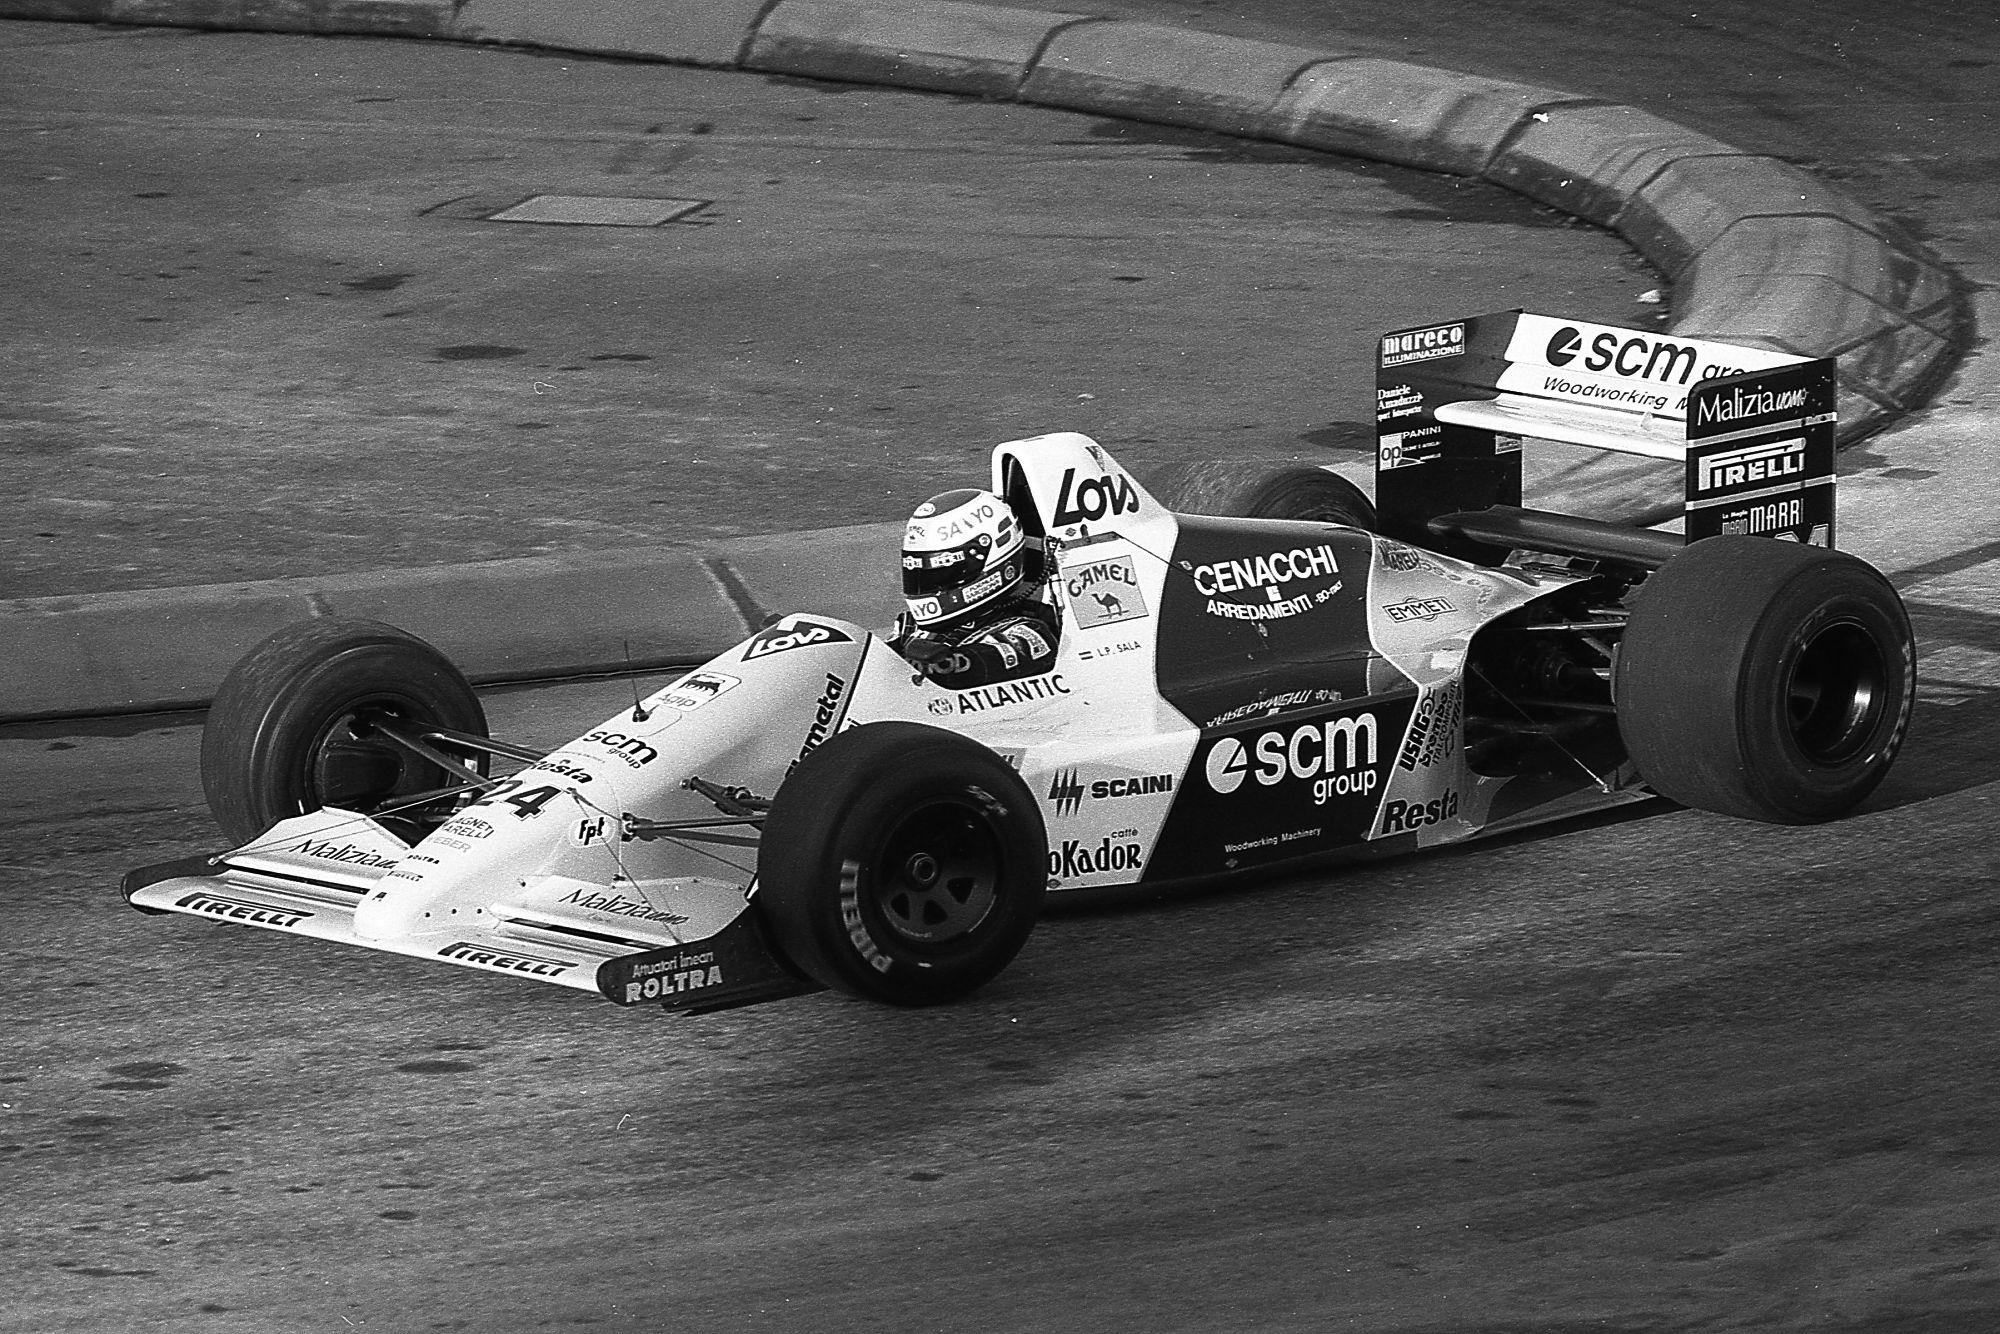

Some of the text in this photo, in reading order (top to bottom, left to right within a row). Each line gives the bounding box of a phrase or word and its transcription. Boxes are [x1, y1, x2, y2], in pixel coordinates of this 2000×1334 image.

[1384, 327, 1463, 355] mareco
[1384, 345, 1463, 365] ILLUMINAZIONE
[1584, 332, 1697, 385] scm
[1543, 376, 1668, 409] Woodworking
[1698, 384, 1774, 426] Malizia
[1402, 426, 1442, 440] PANINI
[1698, 437, 1806, 491] PIRELLI
[1068, 564, 1136, 597] CAMEL
[1194, 545, 1339, 596] CENACCHI
[1206, 594, 1313, 620] ARREDAMENTI
[1387, 600, 1454, 620] EMMETI
[1117, 641, 1141, 653] SALA
[957, 674, 1071, 715] ATLANTIC
[582, 731, 658, 765] scm
[606, 747, 642, 769] group
[1254, 712, 1378, 786] scm
[1399, 712, 1431, 772] USAG
[1091, 774, 1173, 799] SCAINI
[1313, 768, 1377, 805] group
[1381, 786, 1459, 834] Resta
[434, 837, 472, 852] EBER
[578, 817, 605, 845] fpt
[1224, 827, 1322, 853] Woodworking Machinery
[288, 839, 382, 866] Malizia
[175, 892, 315, 928] PIRELLI
[558, 888, 653, 918] Malizia
[840, 859, 893, 974] PIRELLI
[438, 941, 579, 977] PIRELLI
[626, 965, 723, 1003] ROLTRA
